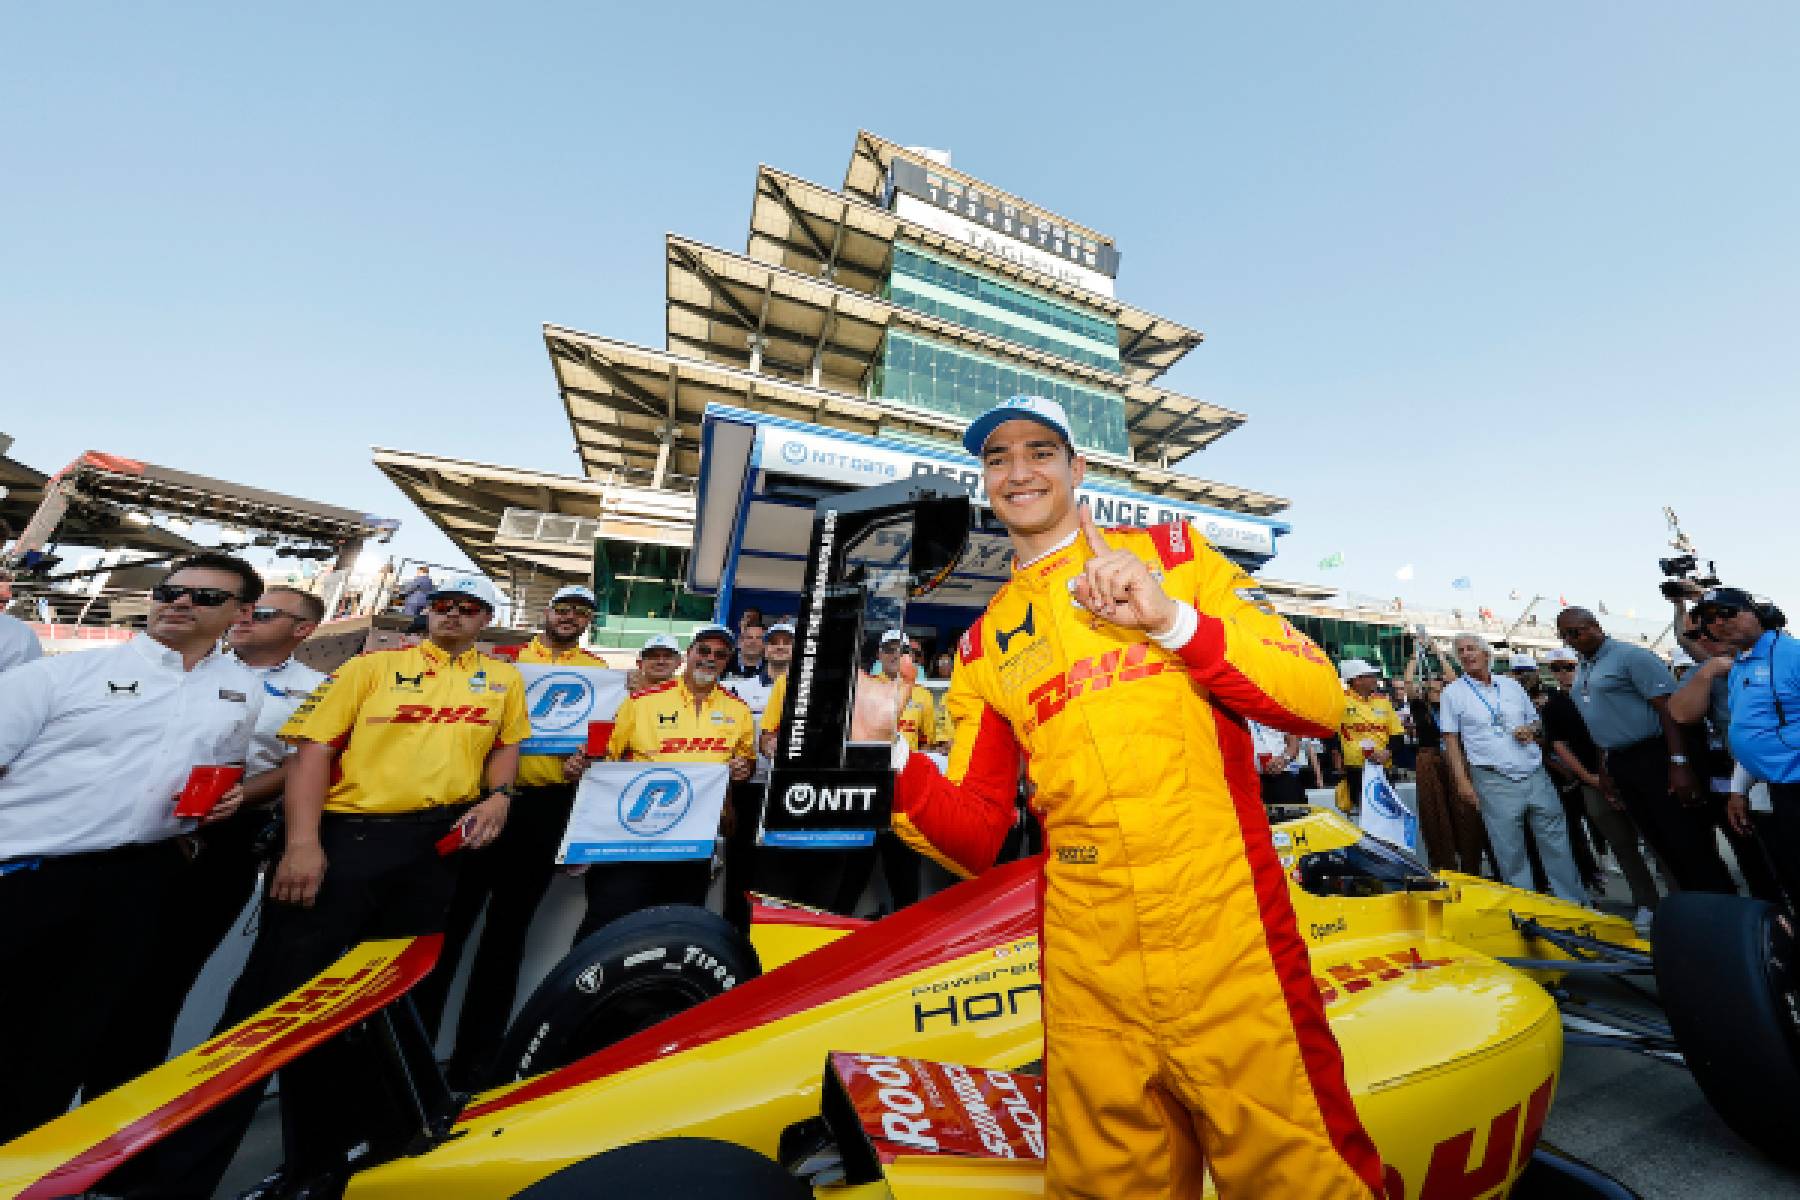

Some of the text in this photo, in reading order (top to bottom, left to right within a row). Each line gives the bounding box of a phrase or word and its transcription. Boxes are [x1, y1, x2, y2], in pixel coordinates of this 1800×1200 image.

[929, 188, 938, 202] 1
[812, 450, 850, 469] NTT
[1028, 642, 1165, 727] DHL
[389, 704, 491, 726] DHL
[659, 737, 730, 754] DHL
[818, 788, 876, 812] NTT
[914, 983, 1041, 1032] Hon
